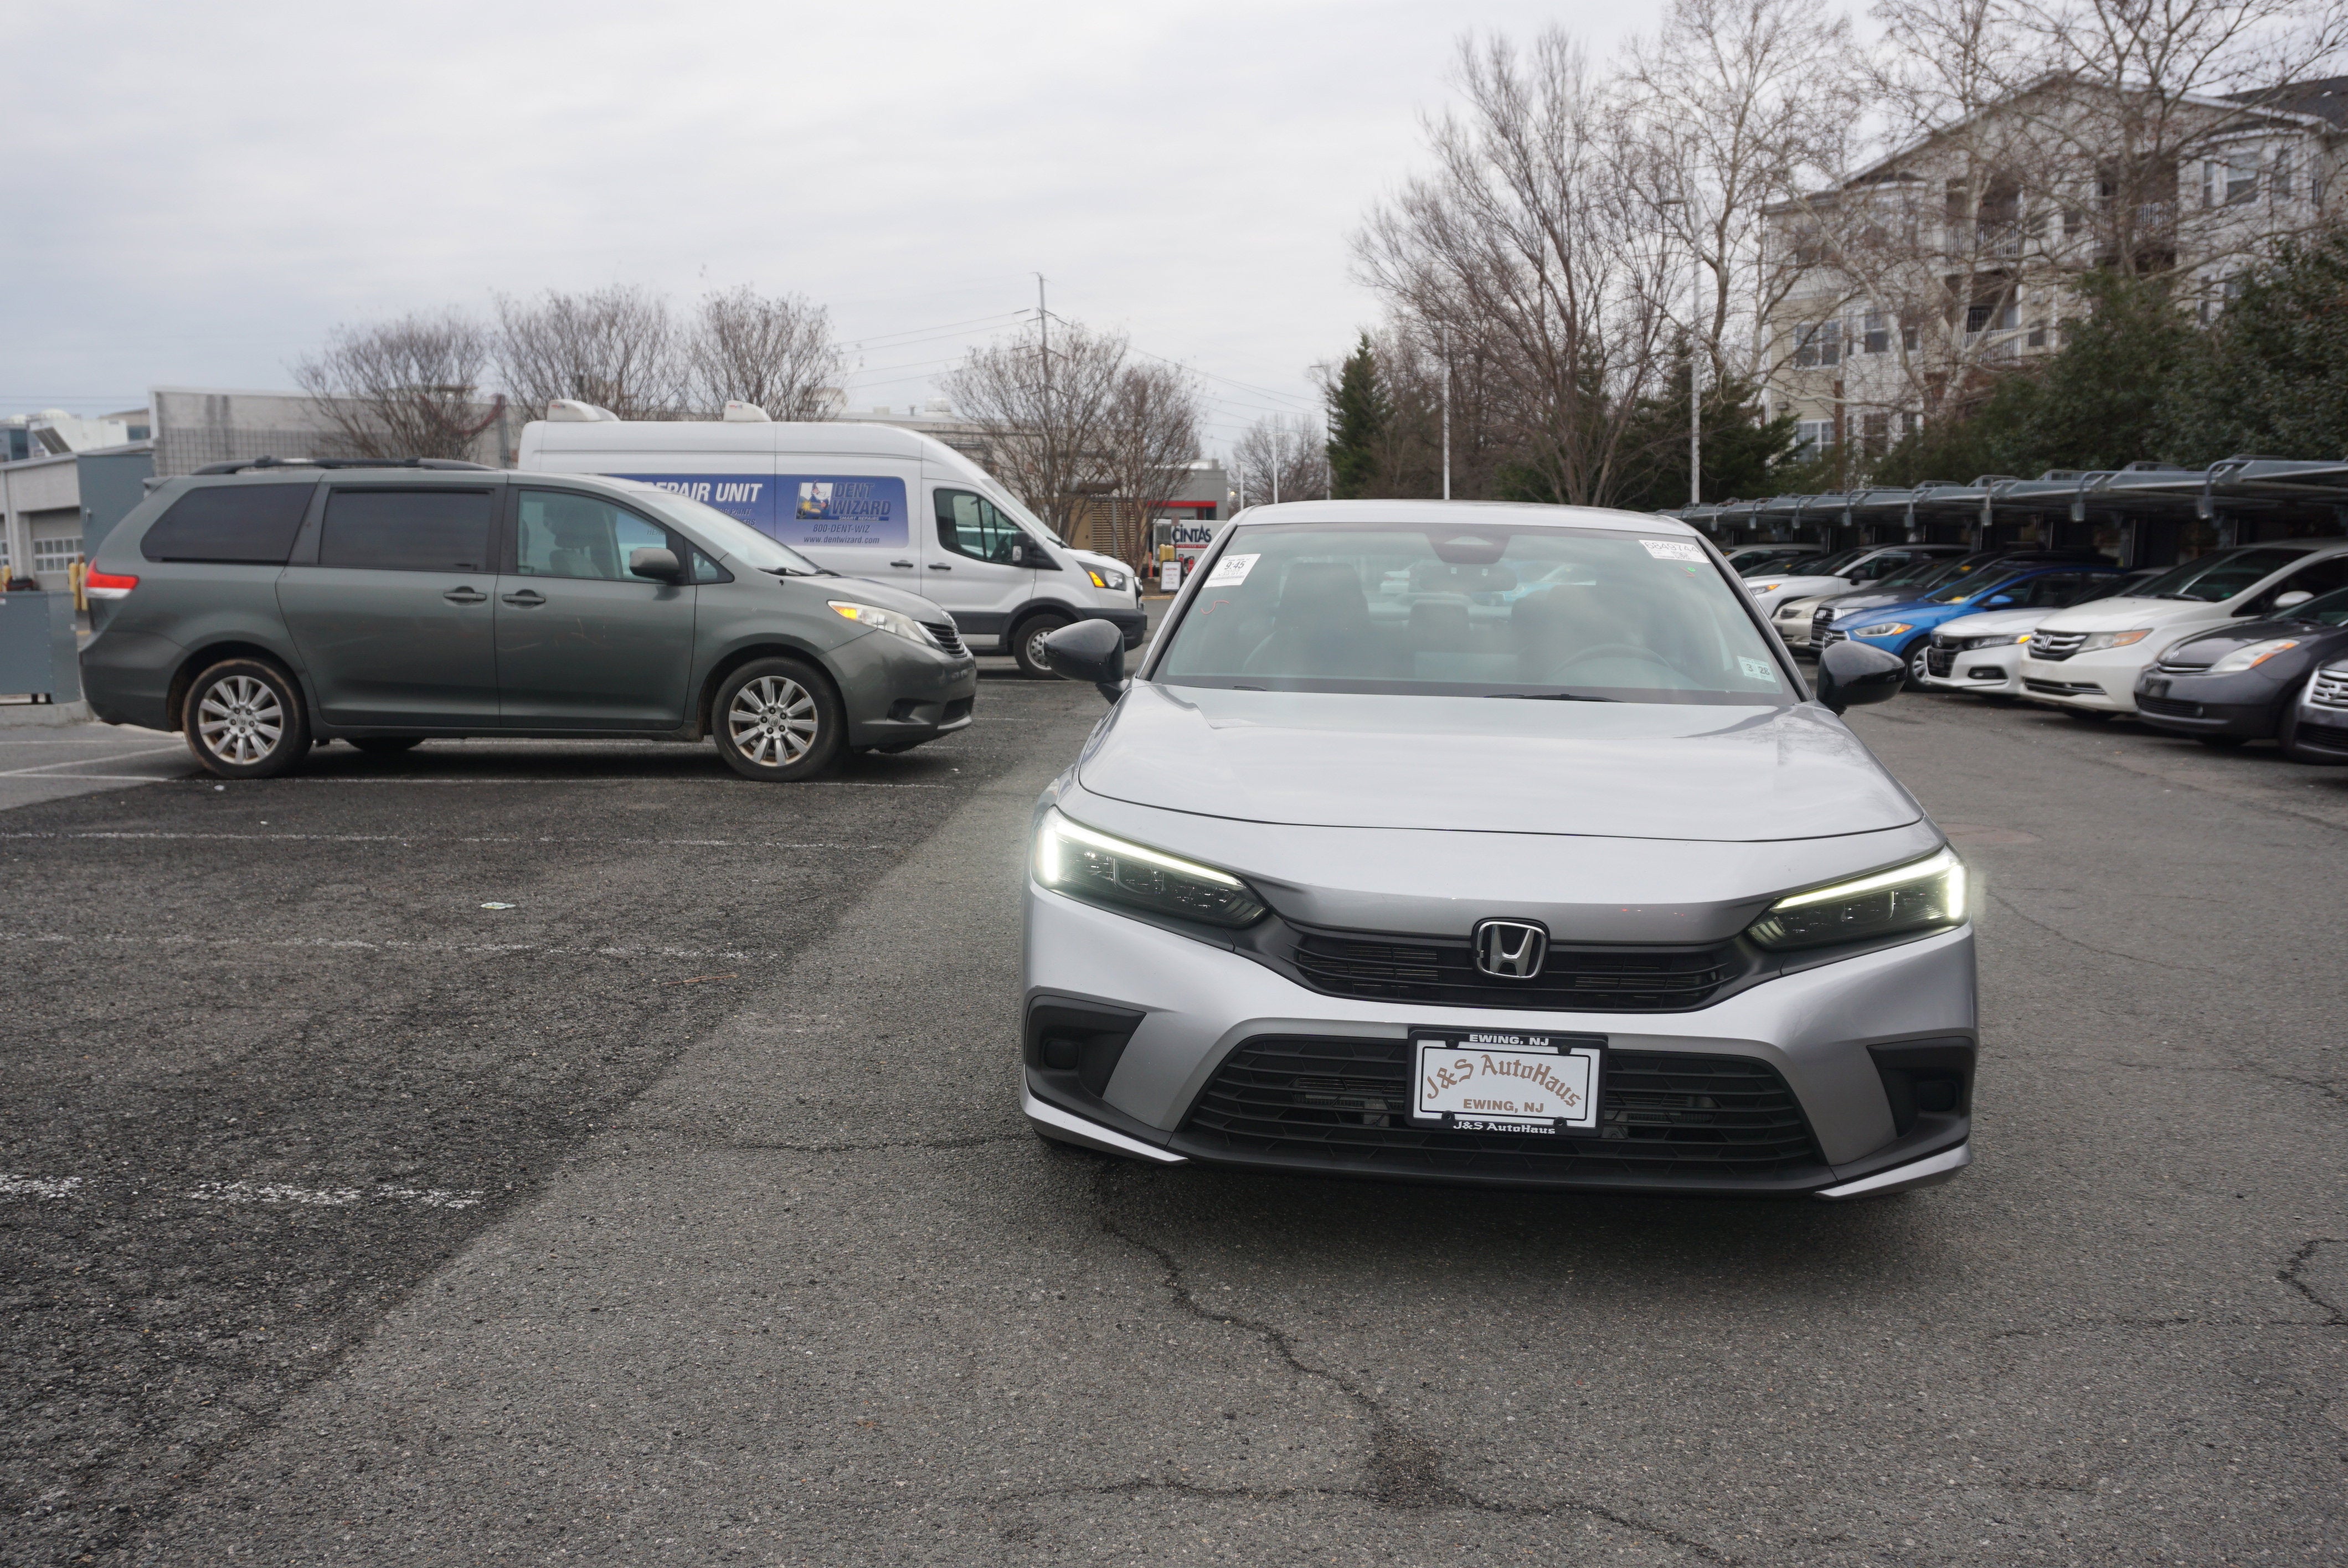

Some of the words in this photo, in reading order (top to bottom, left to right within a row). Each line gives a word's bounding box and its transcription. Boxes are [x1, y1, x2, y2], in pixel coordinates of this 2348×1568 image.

[715, 483, 763, 502] UNIT
[832, 482, 875, 498] DENT
[730, 508, 752, 517] PAINT
[830, 499, 892, 516] WIZARD
[812, 524, 871, 533] 800-DENT-WIZ
[803, 535, 880, 544] www.dentwizard.com
[1224, 561, 1247, 570] 9:45
[1746, 663, 1754, 672] 3
[1758, 666, 1770, 675] 28
[1469, 1034, 1523, 1045] EWING,
[1530, 1037, 1549, 1046] NJ
[1427, 1059, 1474, 1100] J&S
[1480, 1054, 1582, 1108] AutoHaus
[1463, 1098, 1518, 1114] EWING,
[1523, 1102, 1544, 1113] NJ
[1453, 1121, 1483, 1131] J&S
[1486, 1122, 1556, 1134] AutoHaus
